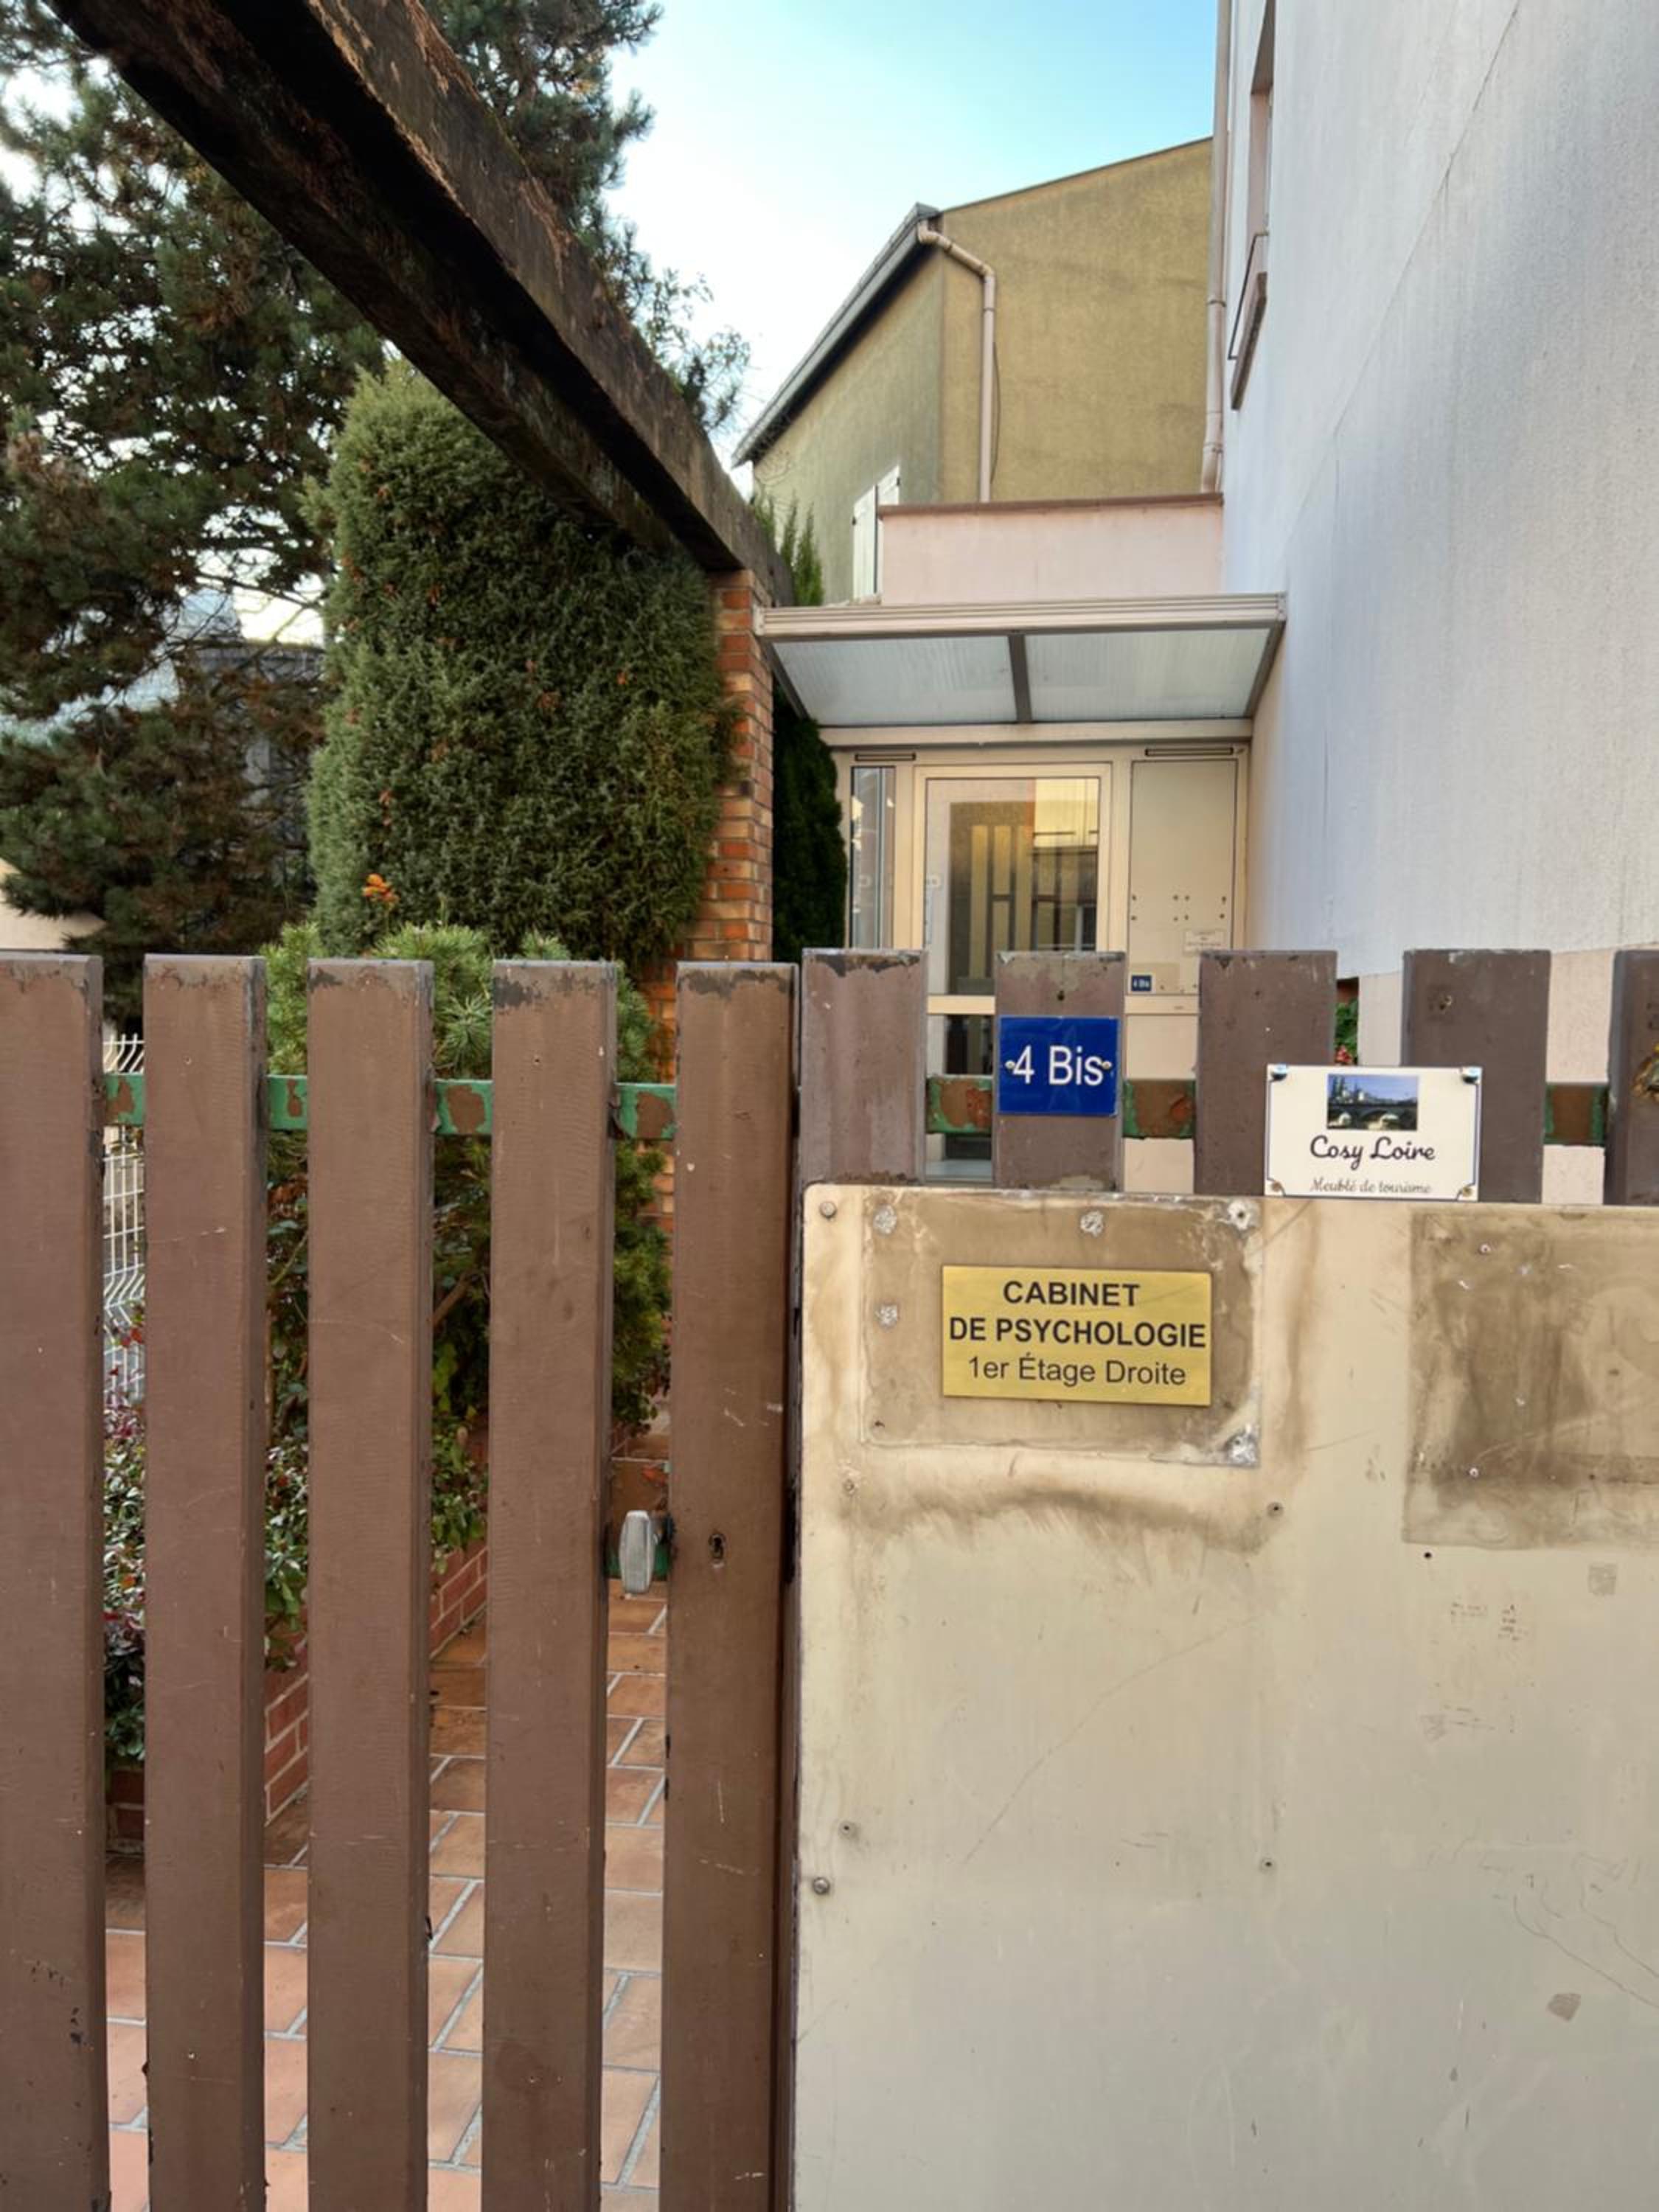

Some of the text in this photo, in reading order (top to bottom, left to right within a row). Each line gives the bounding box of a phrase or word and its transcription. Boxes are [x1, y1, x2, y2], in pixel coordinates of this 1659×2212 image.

[1012, 1044, 1104, 1086] 4 Bis
[1310, 1135, 1436, 1170] Cosy Loire
[1003, 1281, 1140, 1307] CABINET
[950, 1317, 1206, 1348] DE PSYCHOLOGIE
[968, 1352, 1186, 1388] 1er Étage Droite
